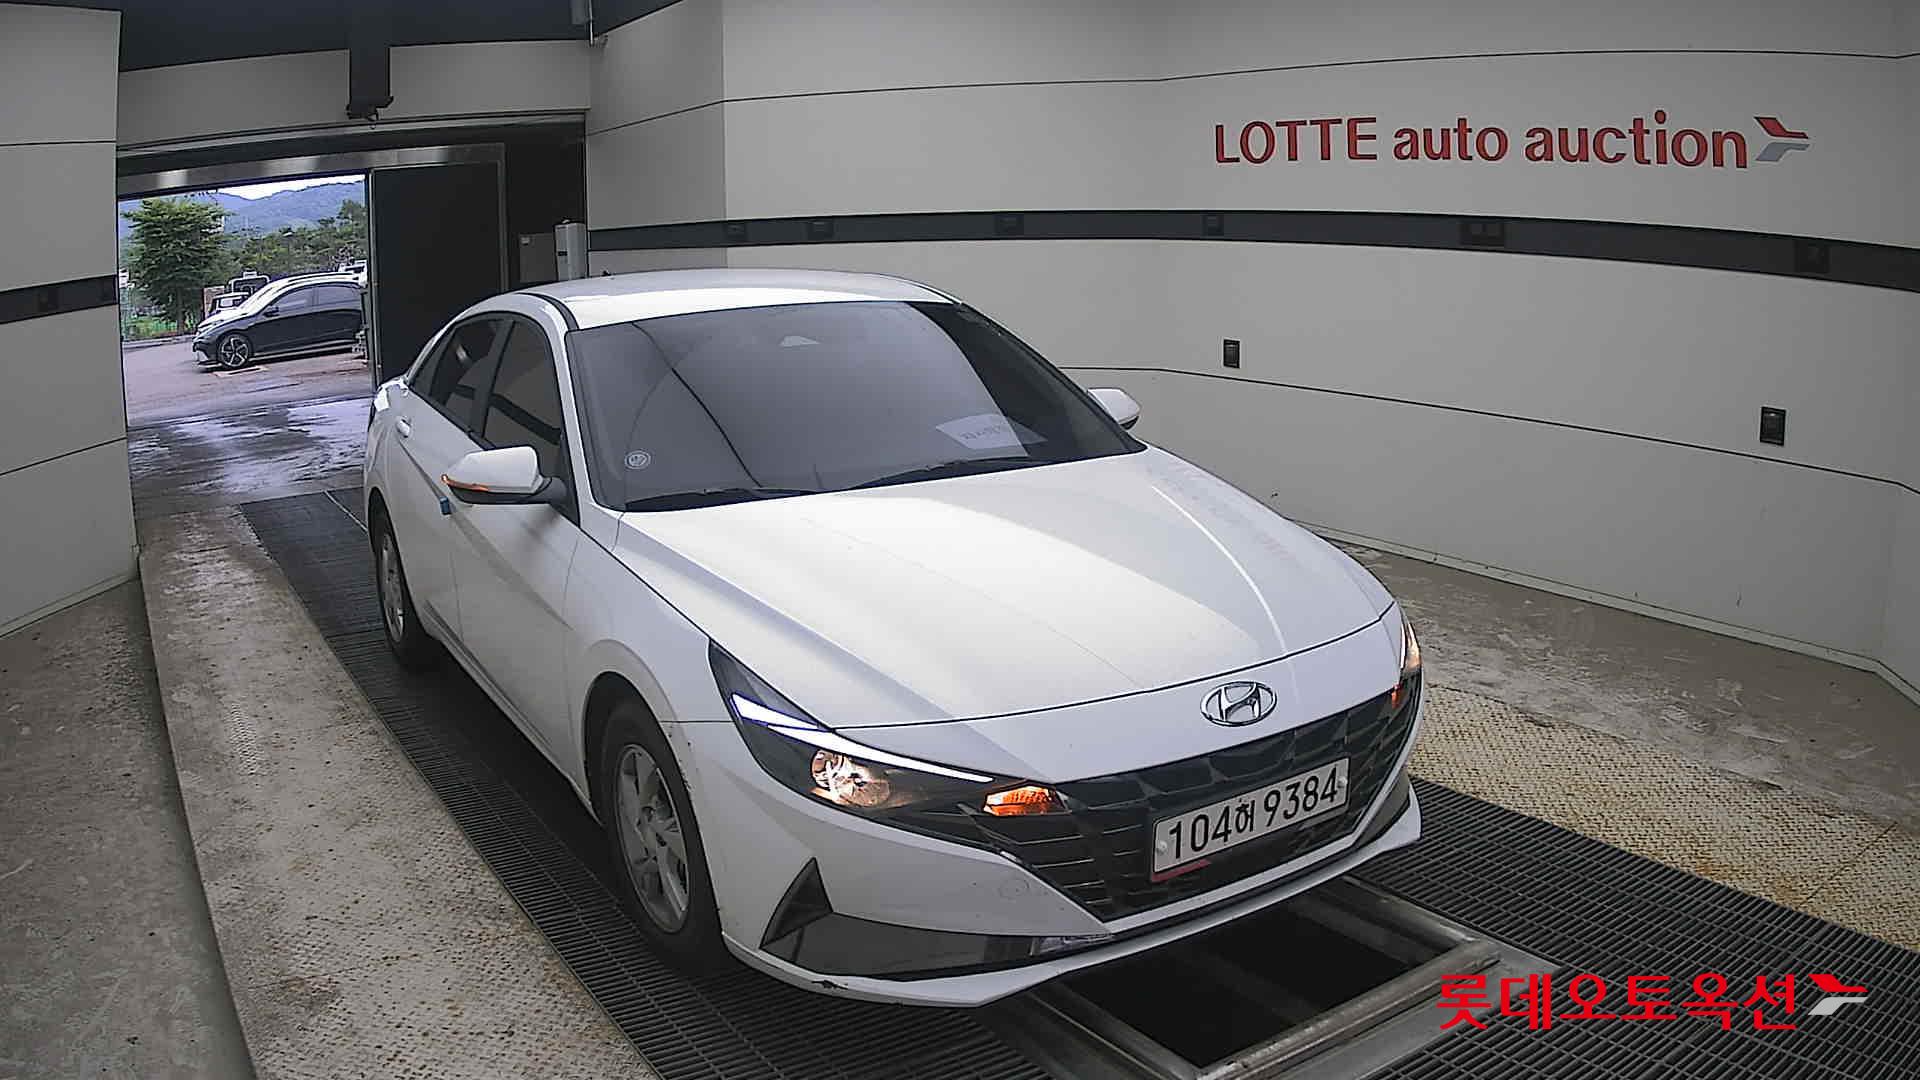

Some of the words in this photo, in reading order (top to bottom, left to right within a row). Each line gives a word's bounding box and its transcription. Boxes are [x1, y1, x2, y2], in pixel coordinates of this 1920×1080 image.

[1214, 117, 1377, 164] LOTTE
[1392, 117, 1508, 162] auto
[1523, 109, 1748, 168] auction
[1263, 766, 1338, 827] 9384
